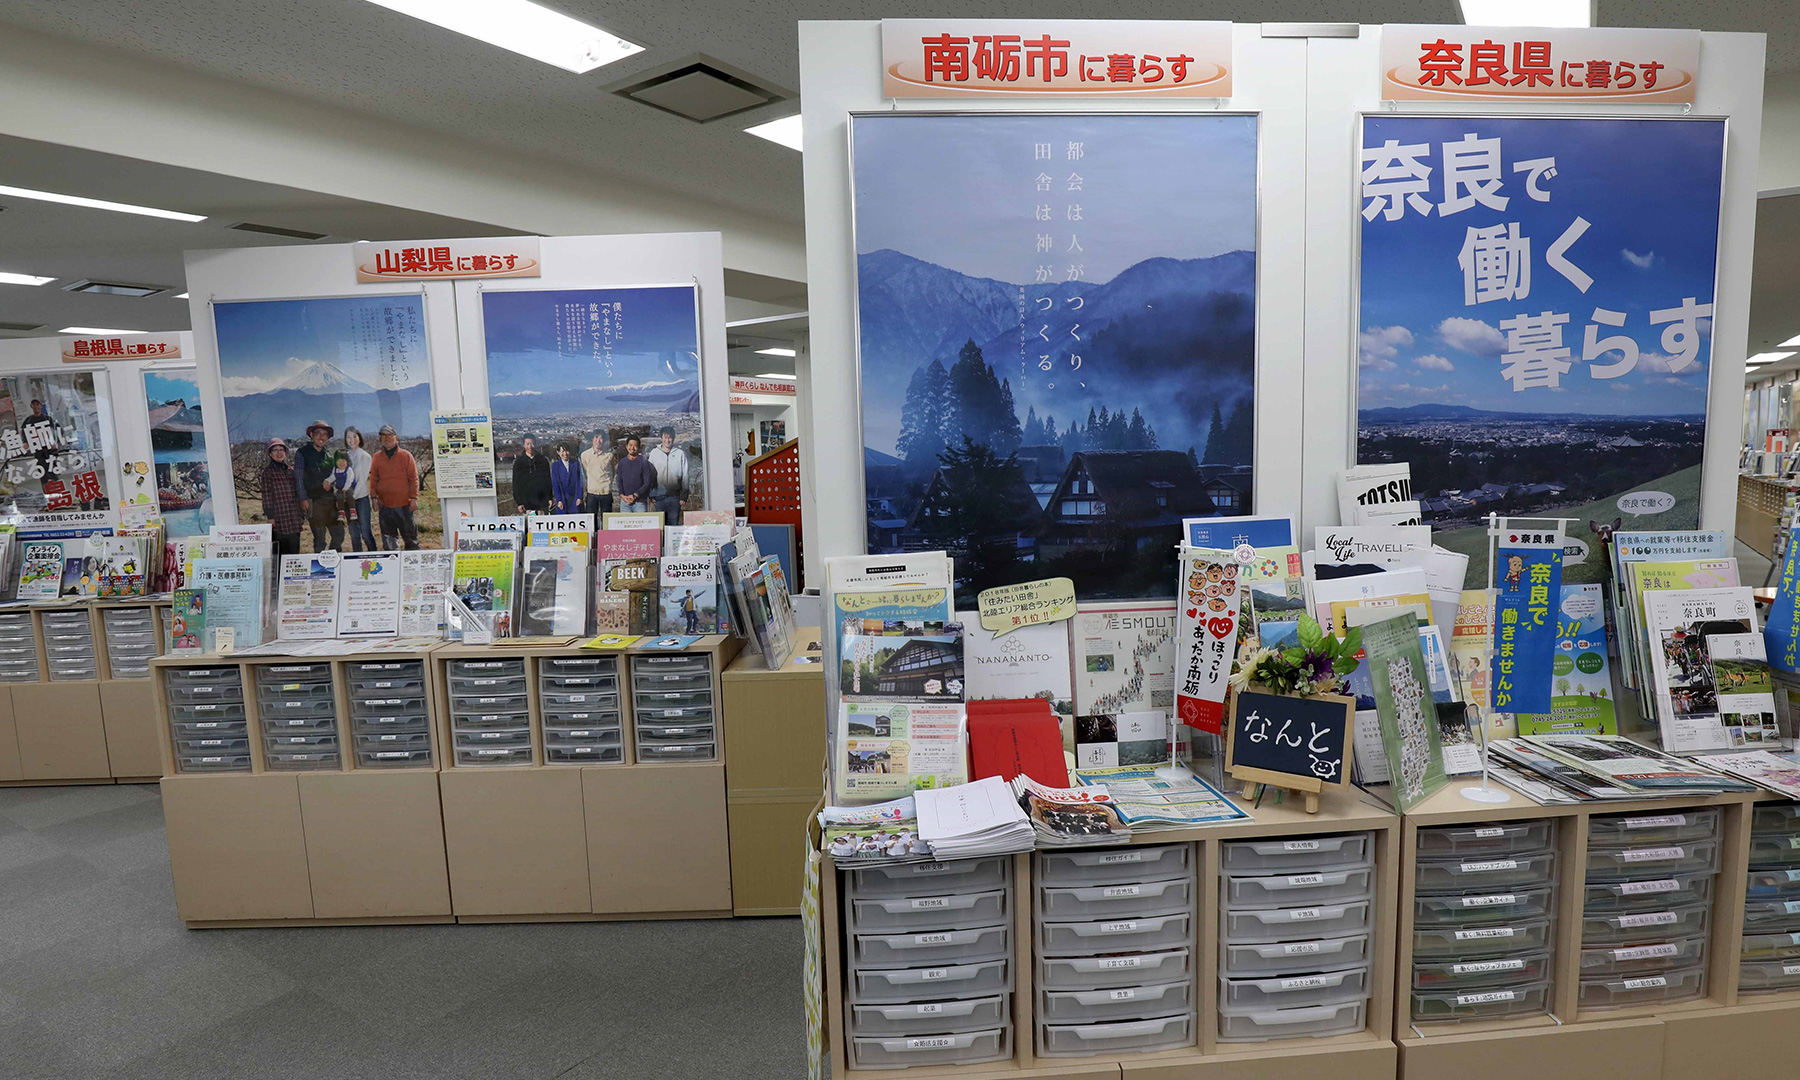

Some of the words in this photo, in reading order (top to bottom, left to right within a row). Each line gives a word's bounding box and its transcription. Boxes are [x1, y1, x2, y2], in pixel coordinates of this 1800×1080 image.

[921, 32, 1195, 82] 南砺市に暮らす
[1418, 38, 1665, 89] 奈良県に暮らす
[1361, 132, 1558, 223] 奈良で
[375, 246, 519, 274] 山梨県に暮らす
[1034, 142, 1055, 390] 田舎は神がつくる。
[1065, 141, 1086, 388] 都会は人がつくり、
[1457, 215, 1594, 307] 働く
[406, 306, 418, 343] 私たちに
[589, 302, 602, 364] 故郷ができた。
[612, 301, 624, 340] 僕たちに
[73, 338, 167, 357] 島根県に暮らす
[383, 306, 400, 386] 故郷ができました。
[1500, 296, 1714, 393] 暮らす
[0, 419, 79, 459] 漁師に
[43, 471, 104, 511] 島根
[603, 543, 655, 552] やまなし子育て
[1325, 533, 1355, 551] Local
[1334, 546, 1357, 563] Life
[1521, 533, 1555, 544] 奈良県
[617, 567, 646, 580] BEEK
[675, 570, 702, 578] press
[1288, 582, 1301, 596] 夏
[1642, 577, 1672, 589] 奈良は
[983, 595, 1074, 618] 北陸エリア総合ランキング
[984, 592, 1040, 606] 「住みたい田舎」
[1527, 563, 1552, 626] 奈良で
[1683, 607, 1717, 619] 奈良町
[976, 653, 1051, 665] NANANANTO
[1182, 625, 1206, 696] あったか南砺
[1496, 607, 1519, 707] 働きませんか
[1244, 709, 1331, 754] なんと
